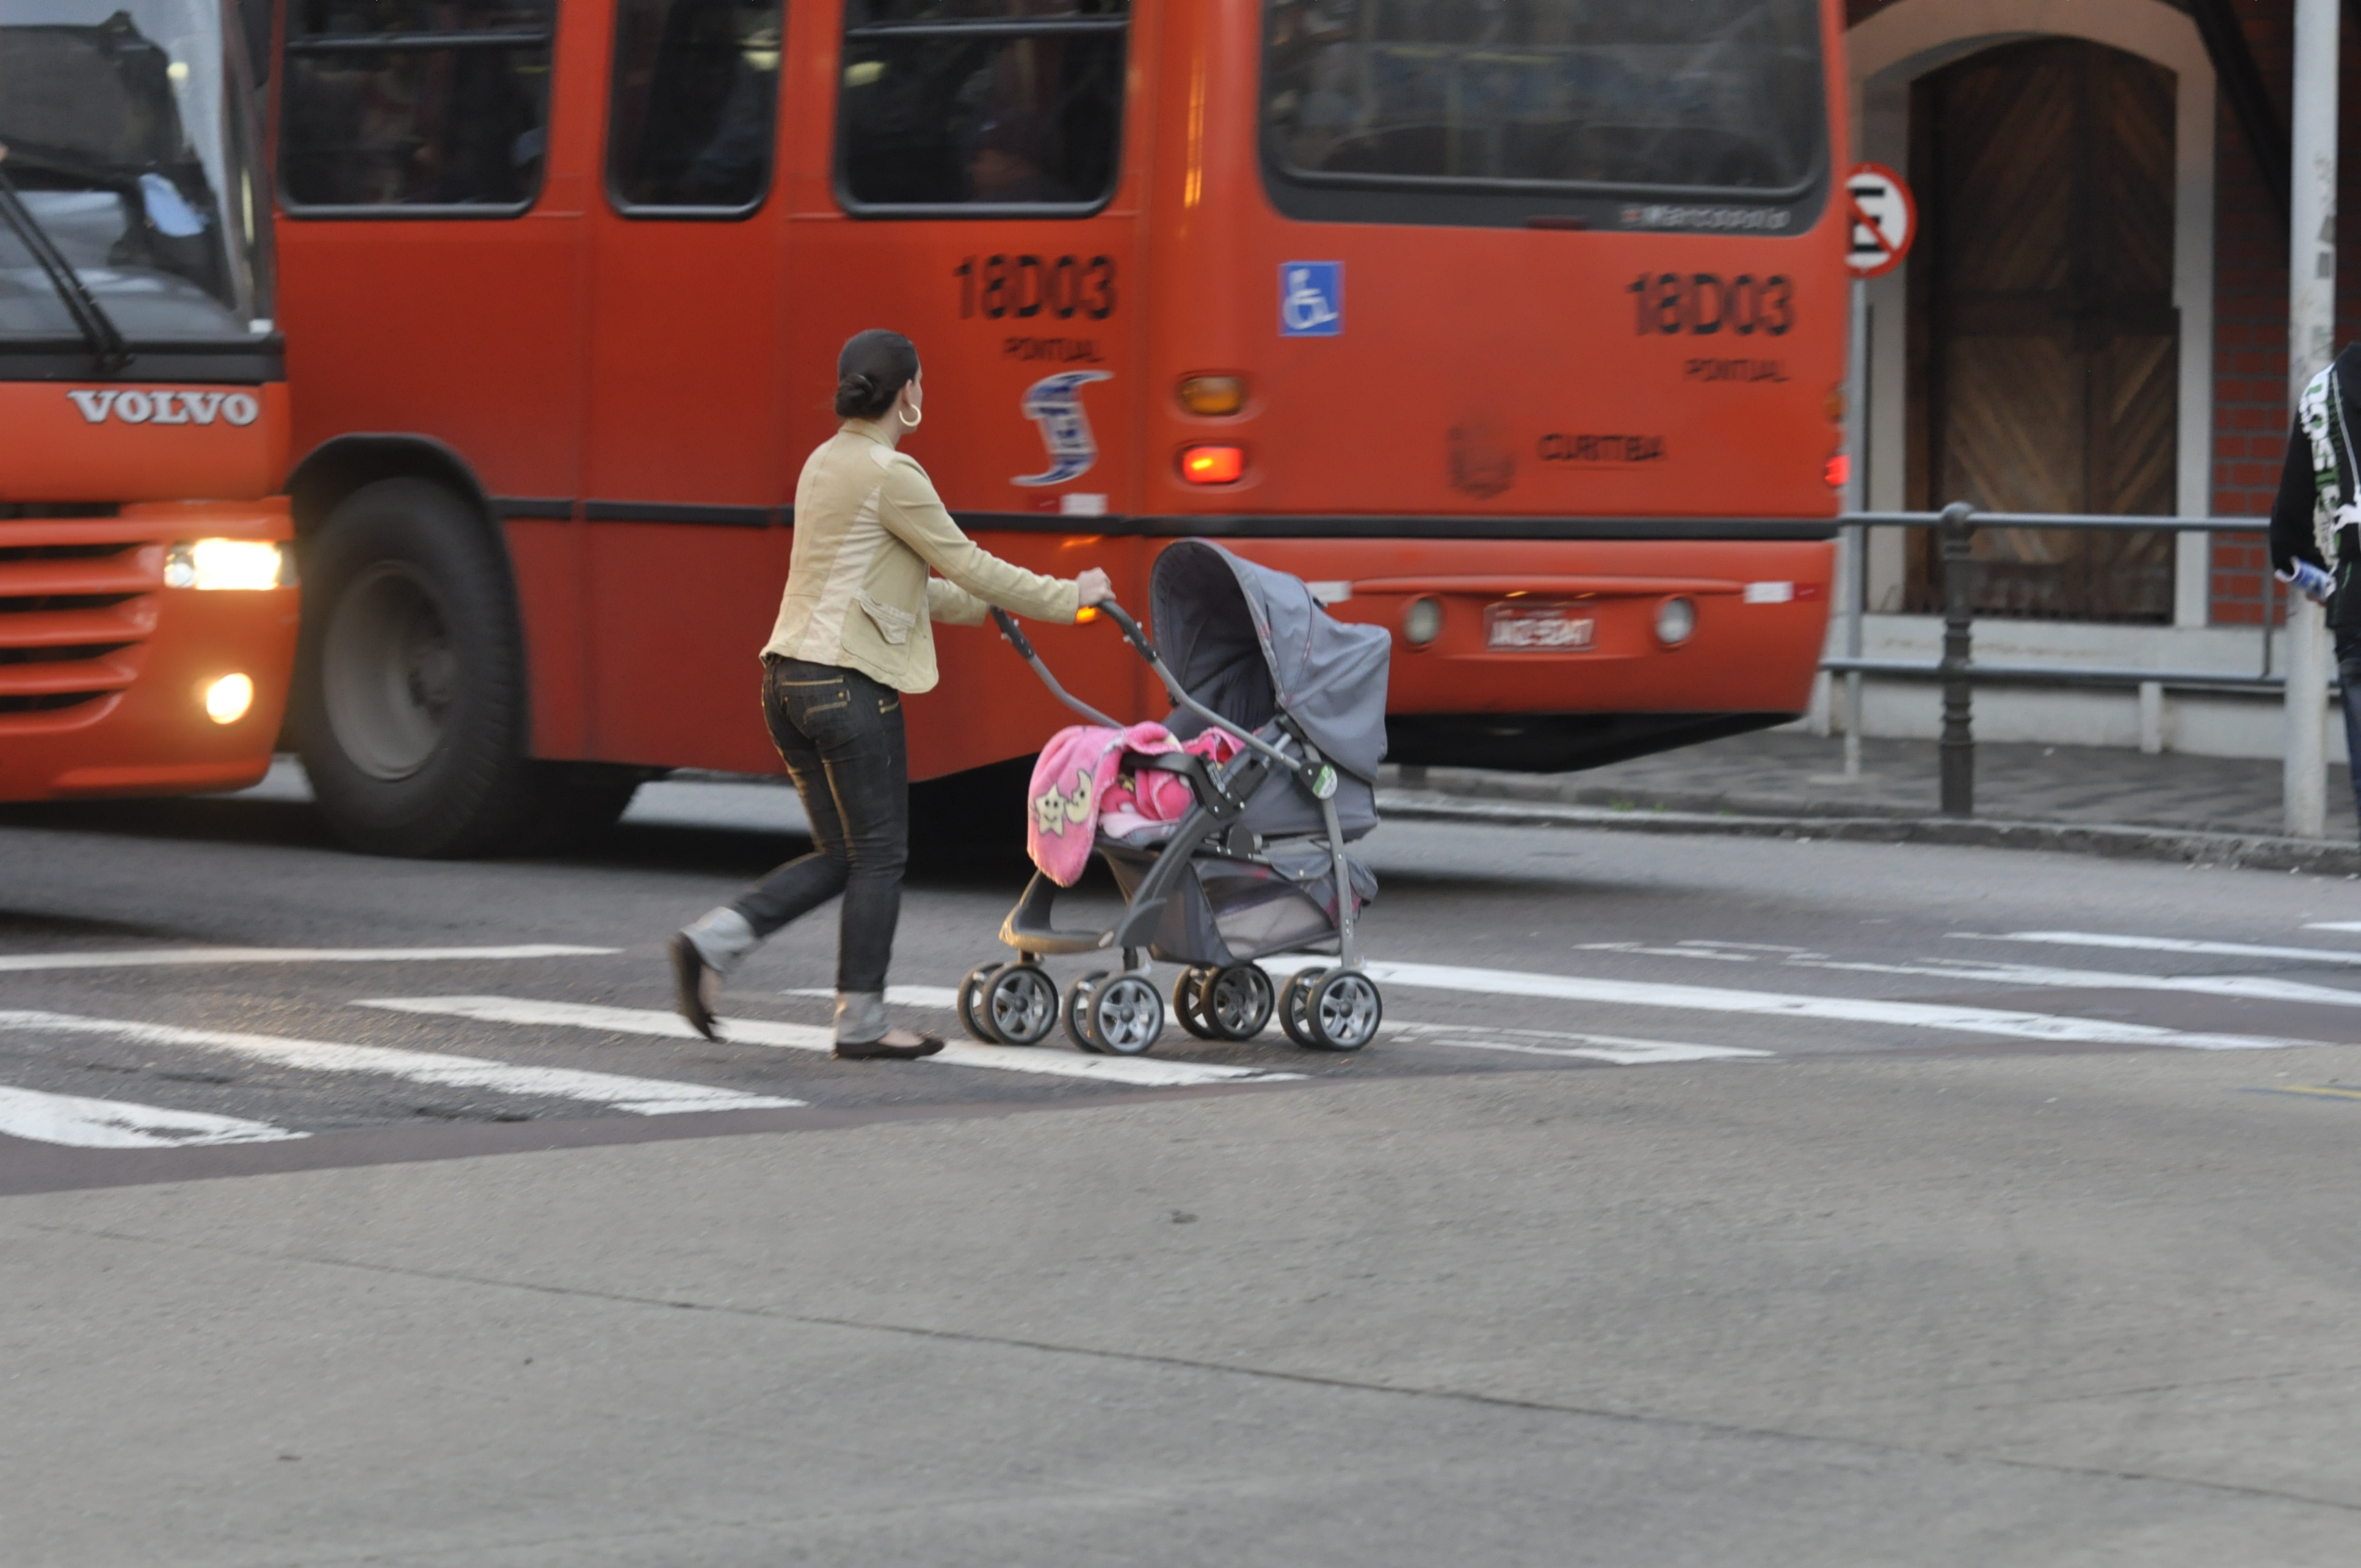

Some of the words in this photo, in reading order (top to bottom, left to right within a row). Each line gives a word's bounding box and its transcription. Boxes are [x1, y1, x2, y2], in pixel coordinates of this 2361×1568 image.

[1643, 206, 1791, 230] Marcopolo
[952, 254, 1118, 320] 18D03
[1625, 272, 1796, 336] 18D03
[1002, 337, 1105, 363] PONTUAL
[1684, 358, 1790, 382] PONTUAL
[67, 390, 259, 426] VOLVO
[1536, 433, 1667, 462] CURITIBA
